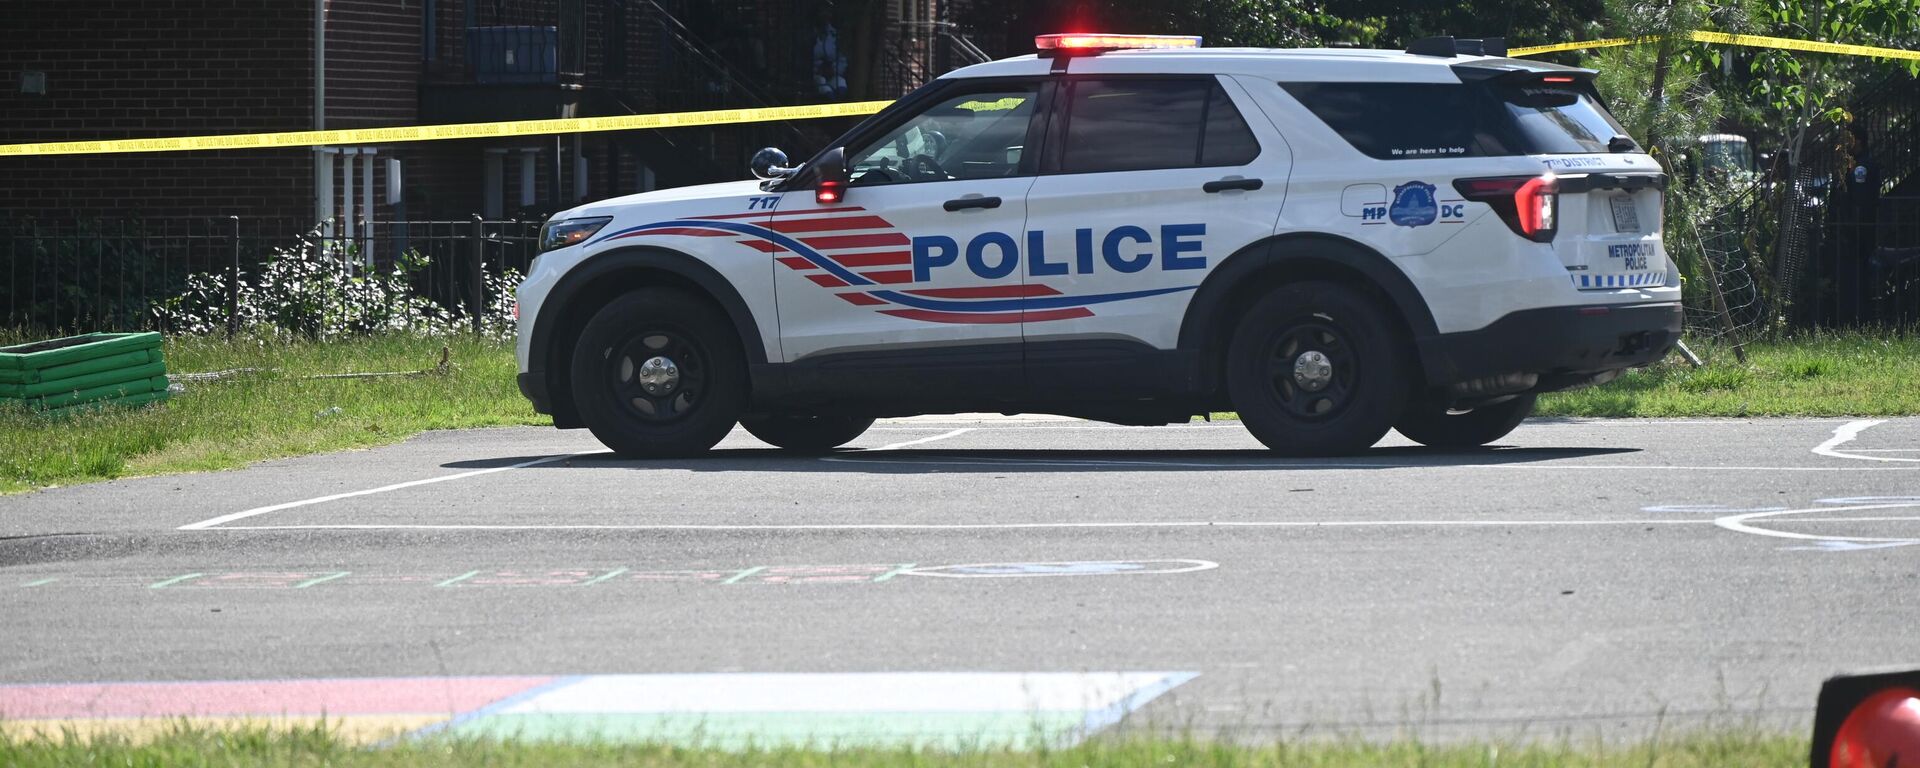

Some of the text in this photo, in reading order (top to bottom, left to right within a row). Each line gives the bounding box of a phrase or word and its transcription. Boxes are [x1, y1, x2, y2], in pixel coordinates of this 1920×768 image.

[1562, 158, 1606, 168] DISTRICT
[748, 196, 780, 210] 717
[1362, 204, 1464, 220] MP DC
[912, 223, 1207, 282] POLICE
[1608, 243, 1656, 258] METROPOLITAN
[1625, 257, 1648, 270] POLICE
